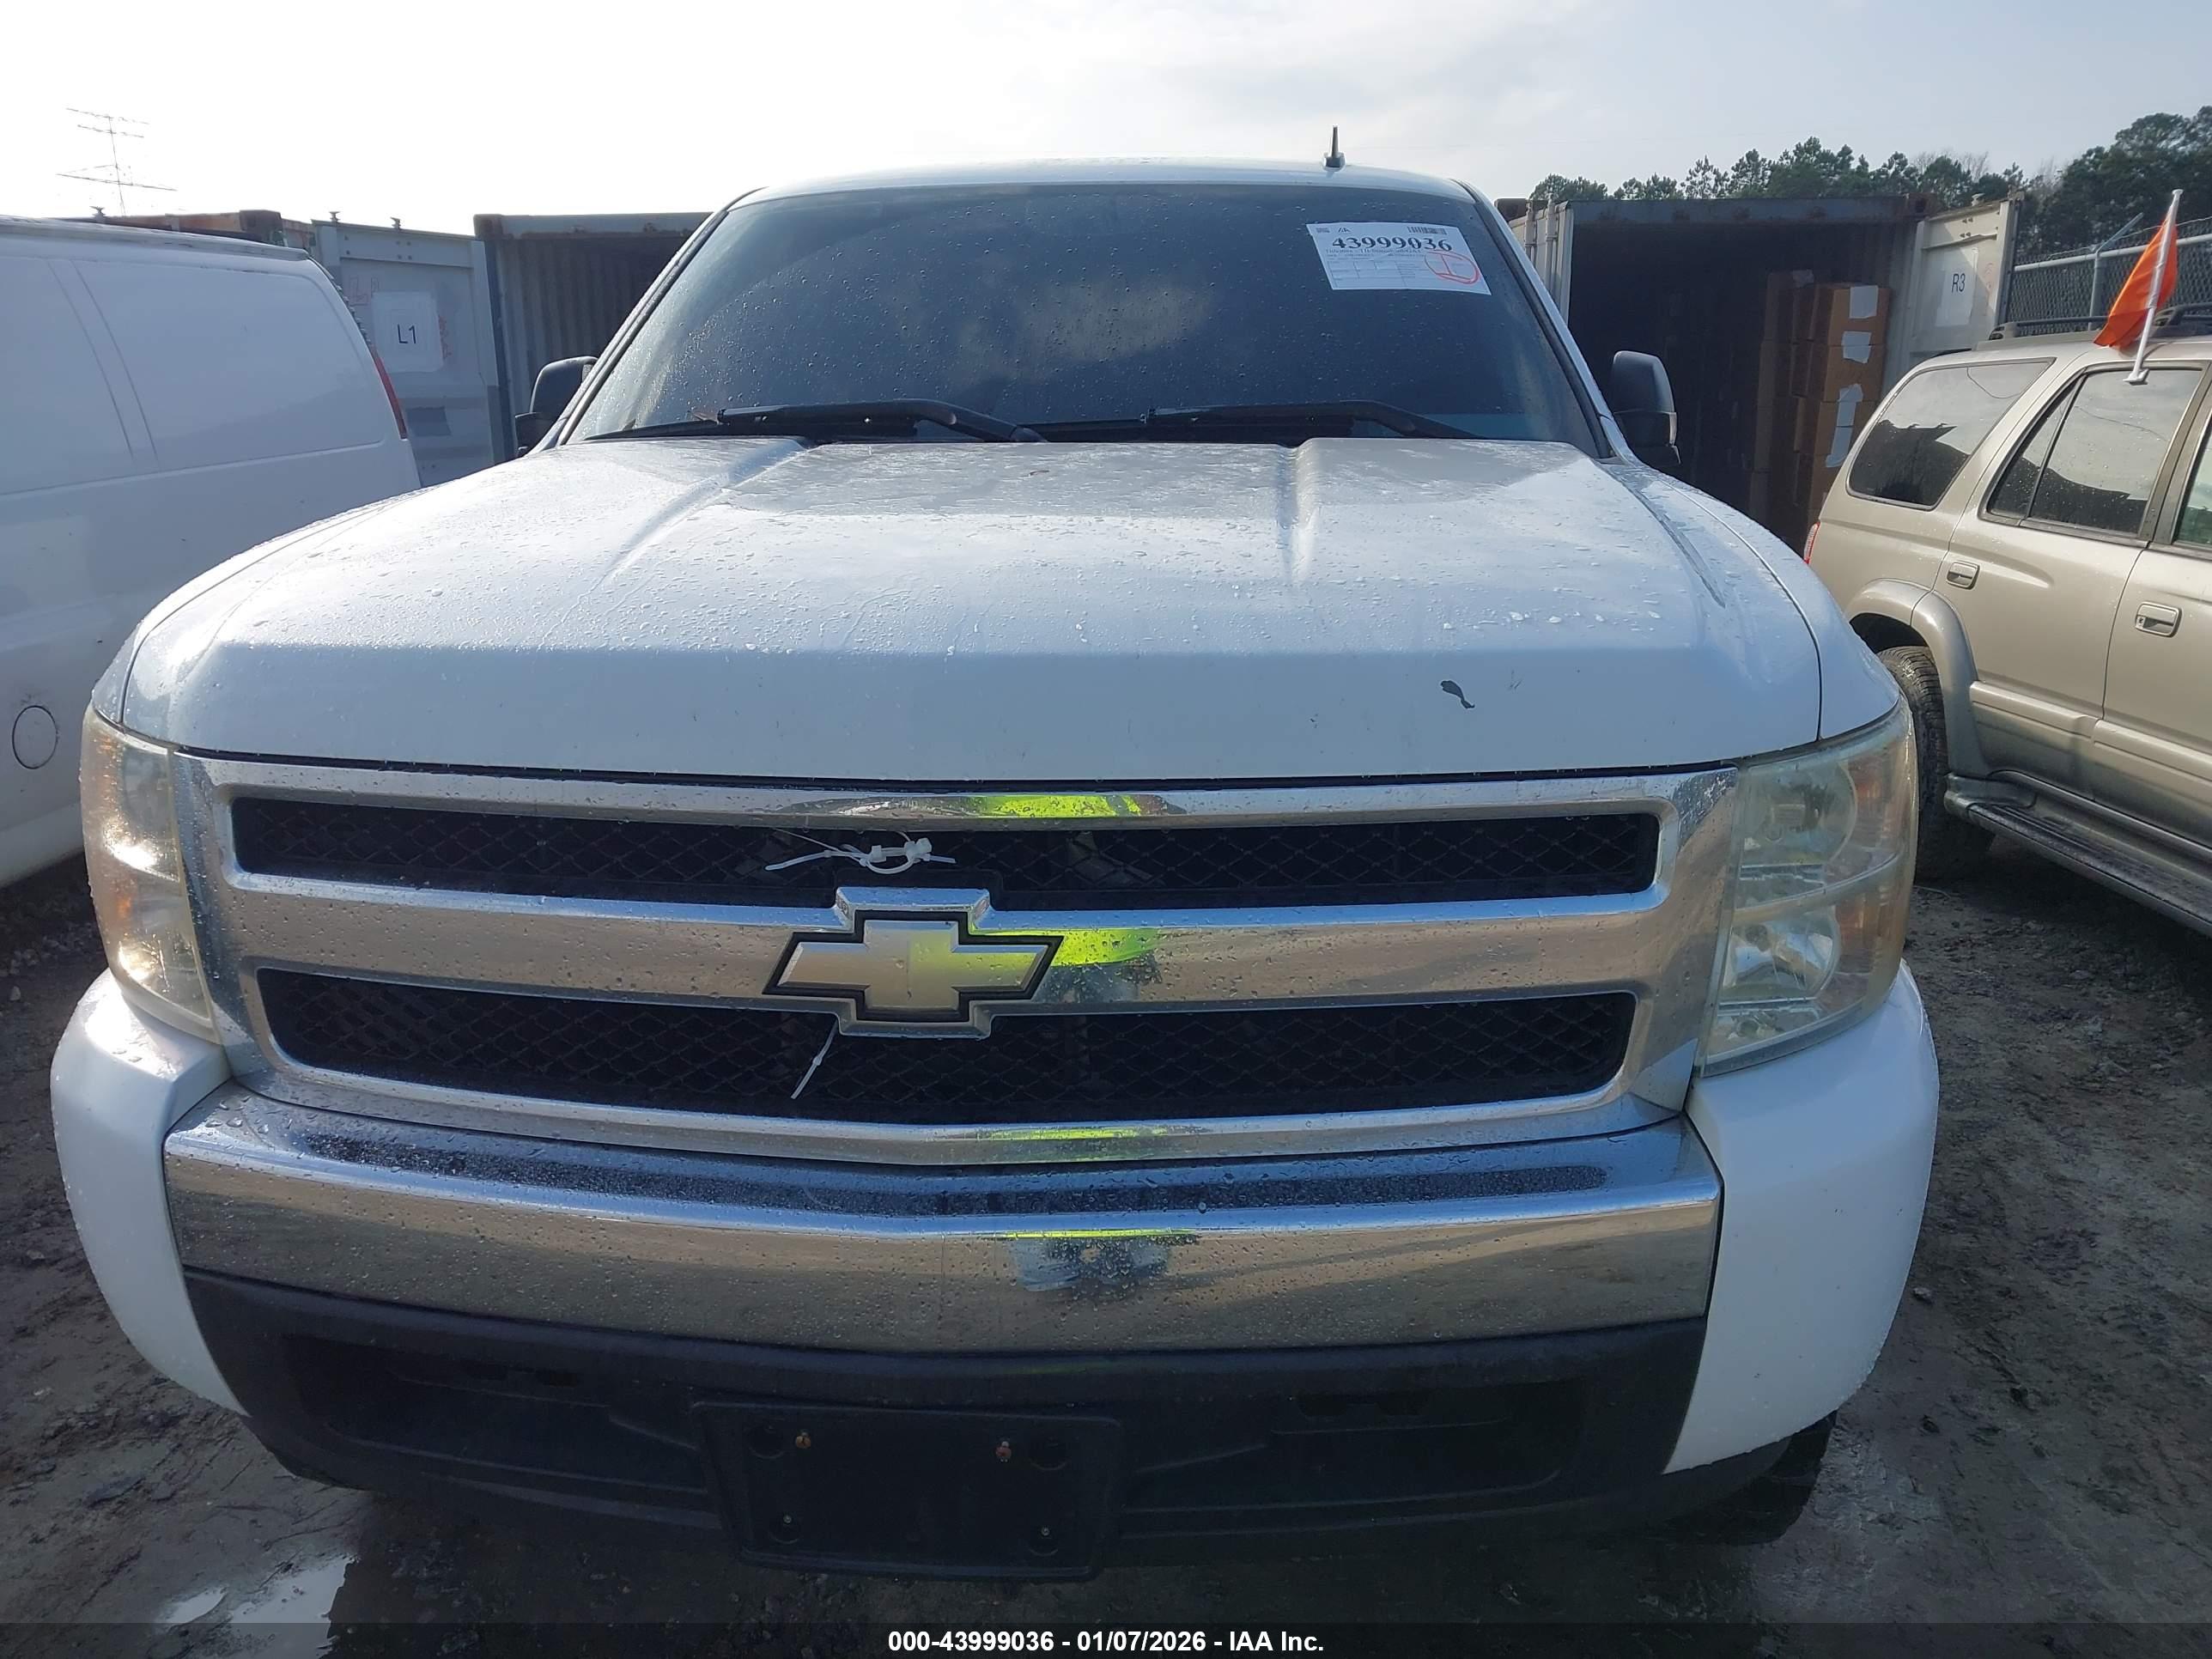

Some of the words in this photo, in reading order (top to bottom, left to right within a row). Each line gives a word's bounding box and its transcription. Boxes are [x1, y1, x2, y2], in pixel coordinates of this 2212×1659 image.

[1332, 236, 1453, 252] 43999036
[1951, 272, 1966, 294] R3
[397, 324, 416, 344] L1
